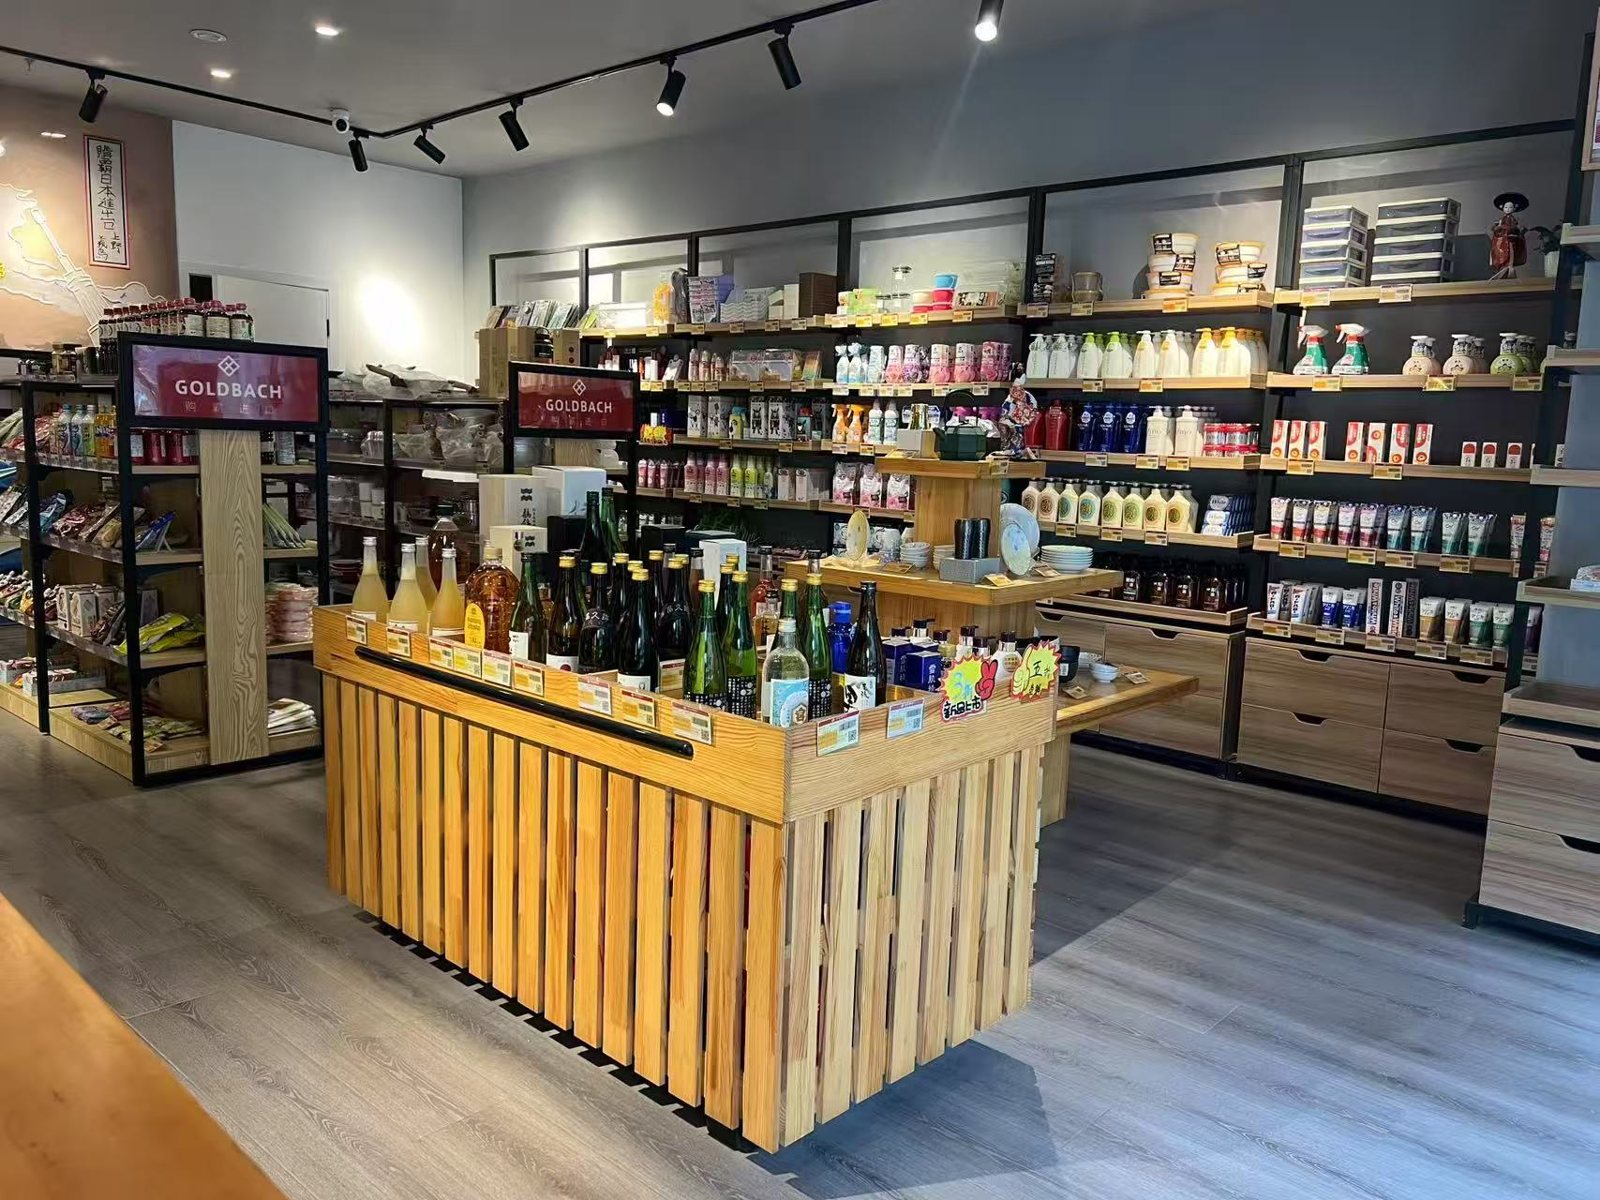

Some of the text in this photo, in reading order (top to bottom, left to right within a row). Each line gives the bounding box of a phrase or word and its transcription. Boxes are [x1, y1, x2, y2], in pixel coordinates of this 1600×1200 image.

[175, 379, 283, 399] GOLDBACH
[545, 399, 612, 413] GOLDBACH
[943, 695, 982, 719] 新品上市
